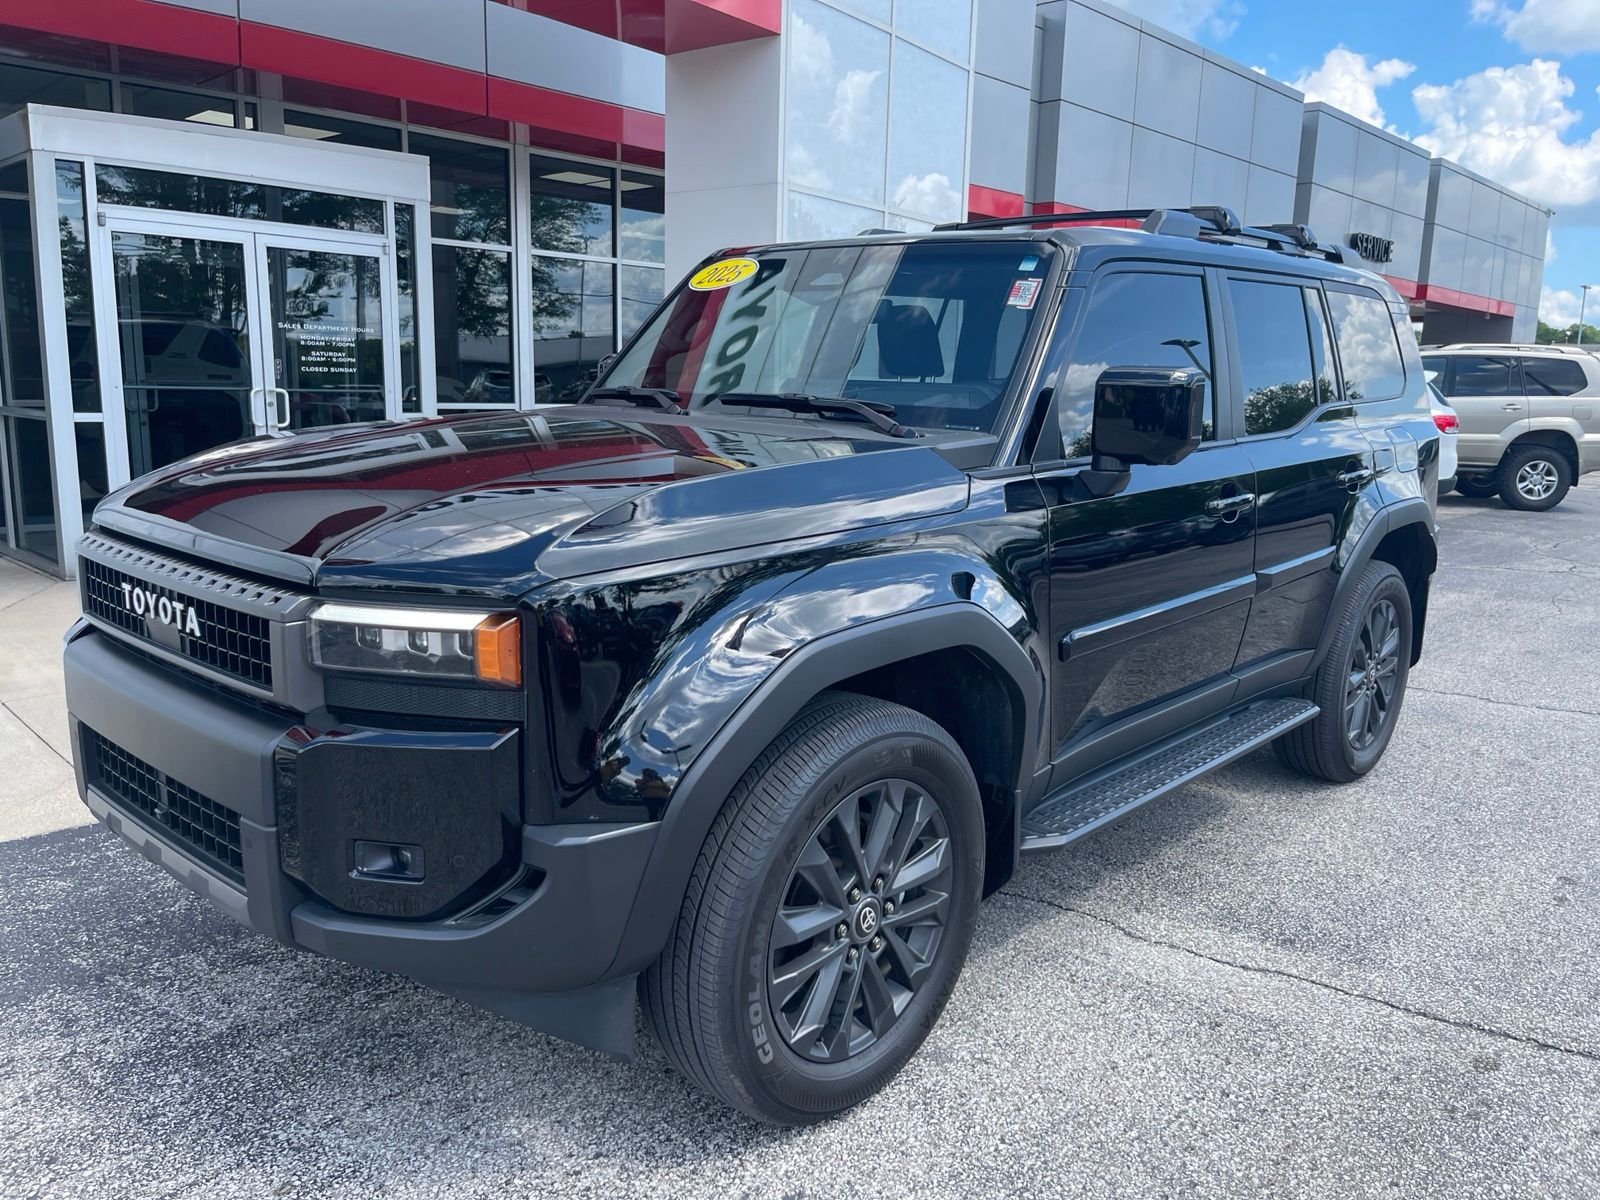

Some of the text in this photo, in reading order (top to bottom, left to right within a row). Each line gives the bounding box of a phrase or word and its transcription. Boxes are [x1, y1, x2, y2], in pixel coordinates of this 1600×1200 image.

[1357, 233, 1394, 263] SERVICE
[696, 264, 750, 285] 2025
[121, 582, 201, 637] TOYOTA
